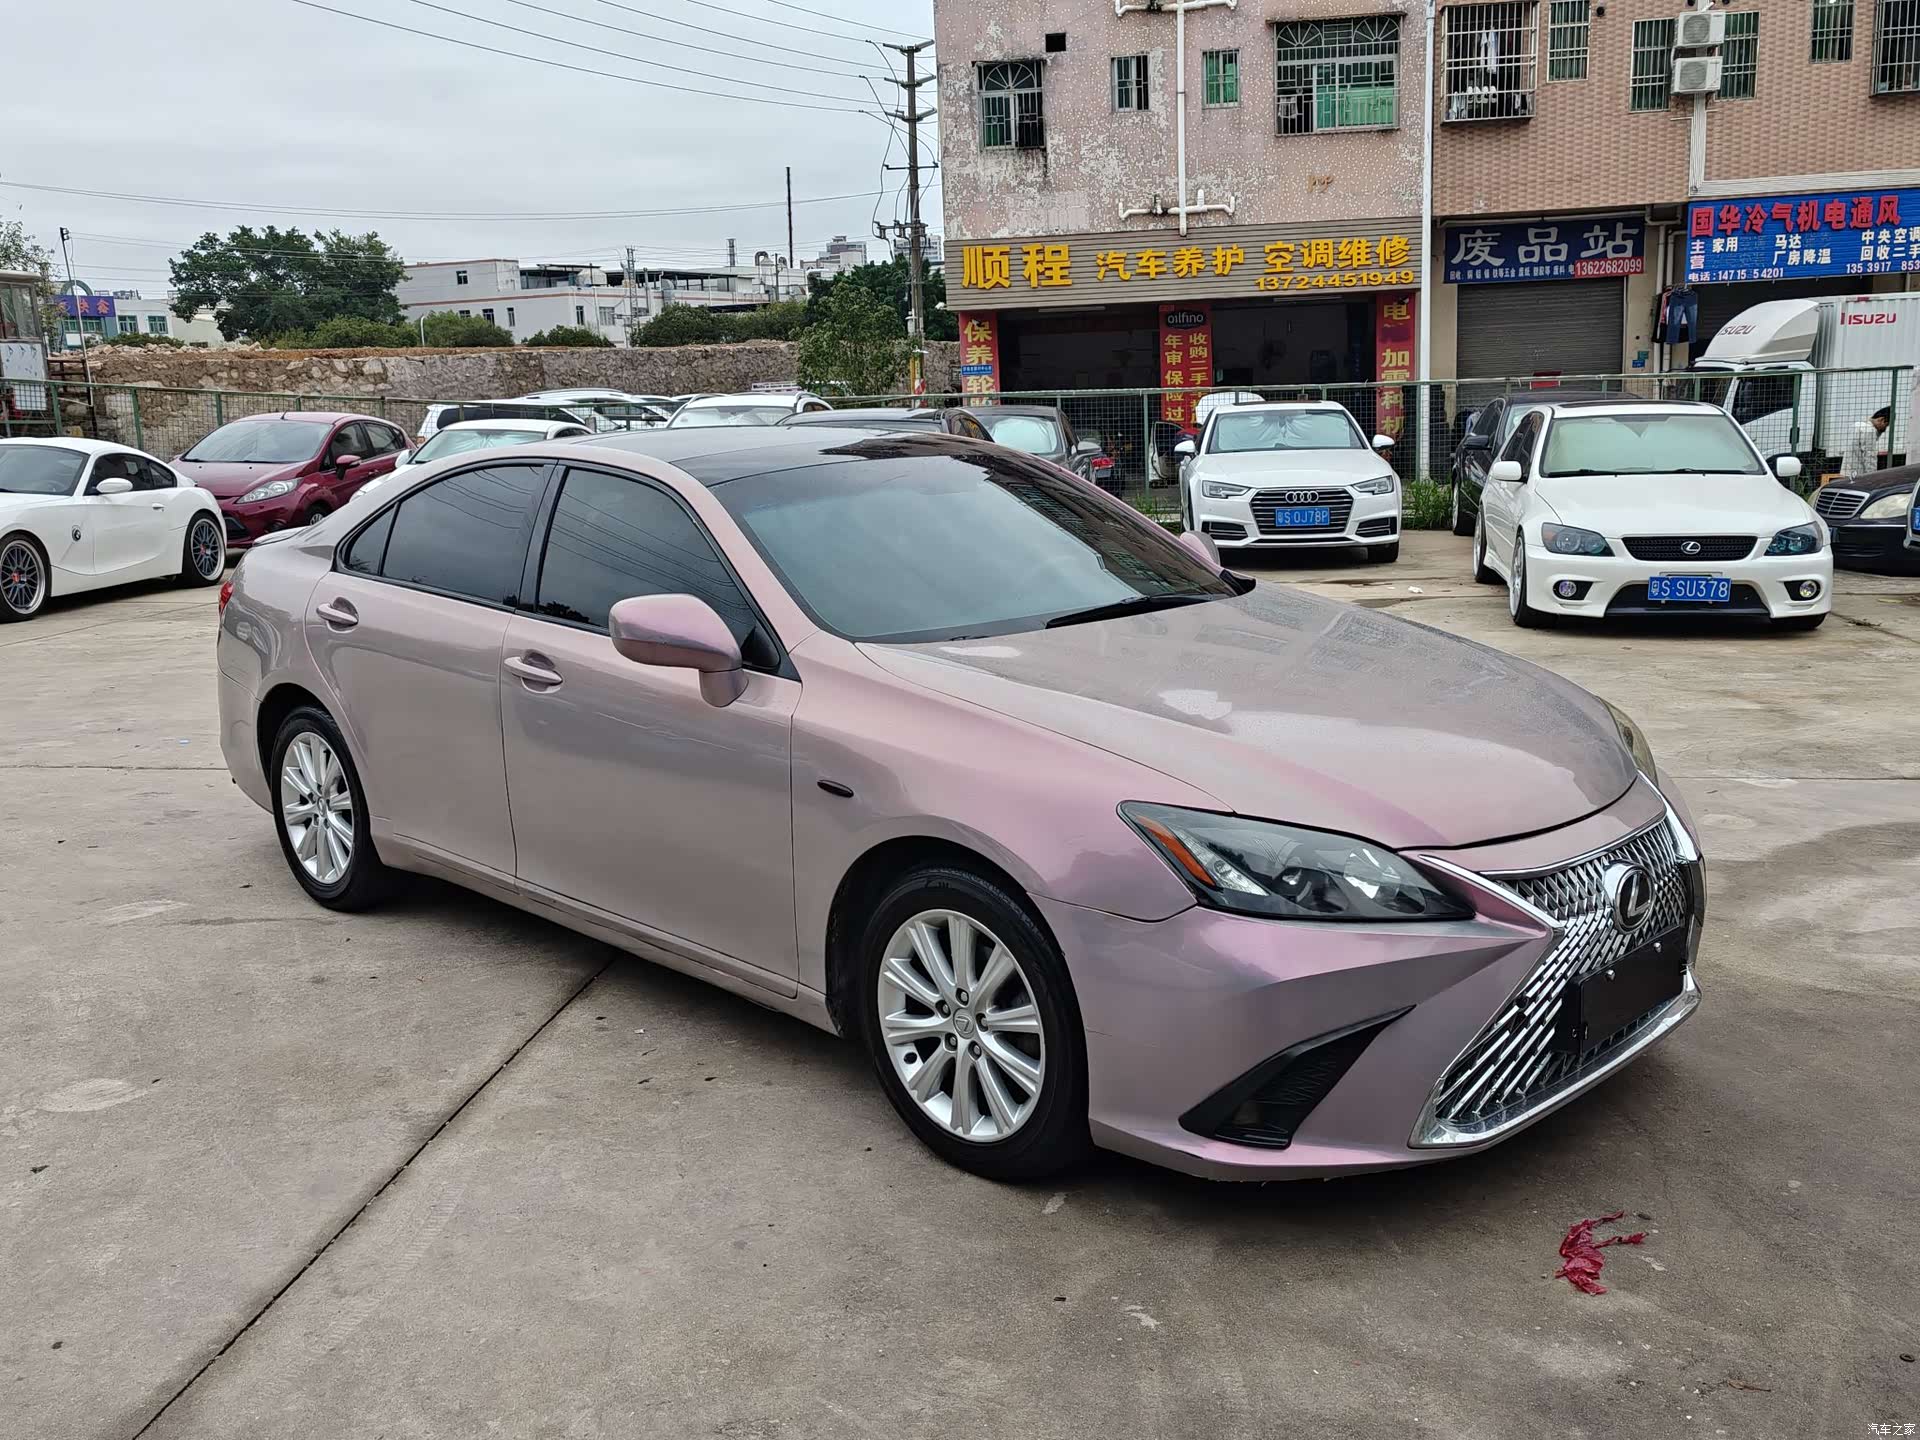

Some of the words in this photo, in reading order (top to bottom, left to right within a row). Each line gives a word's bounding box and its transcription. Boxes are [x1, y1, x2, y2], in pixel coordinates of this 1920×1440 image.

[1691, 195, 1902, 238] 国华冷气机电通风
[1450, 222, 1640, 266] 废品站
[1690, 239, 1705, 270] 主营
[1712, 236, 1739, 254] 家用
[1775, 233, 1802, 249] 马达
[1772, 248, 1832, 266] 厂房降温
[1860, 243, 1920, 262] 回收二手
[962, 243, 1072, 290] 顺程
[1096, 244, 1245, 281] 汽车养护
[1263, 234, 1411, 274] 空调维修
[1575, 259, 1642, 277] 13622682099
[1255, 269, 1415, 291] 13724451949
[1167, 311, 1204, 324] oilfino
[1848, 312, 1897, 325] ISUZU
[1718, 324, 1757, 336] ISUZU
